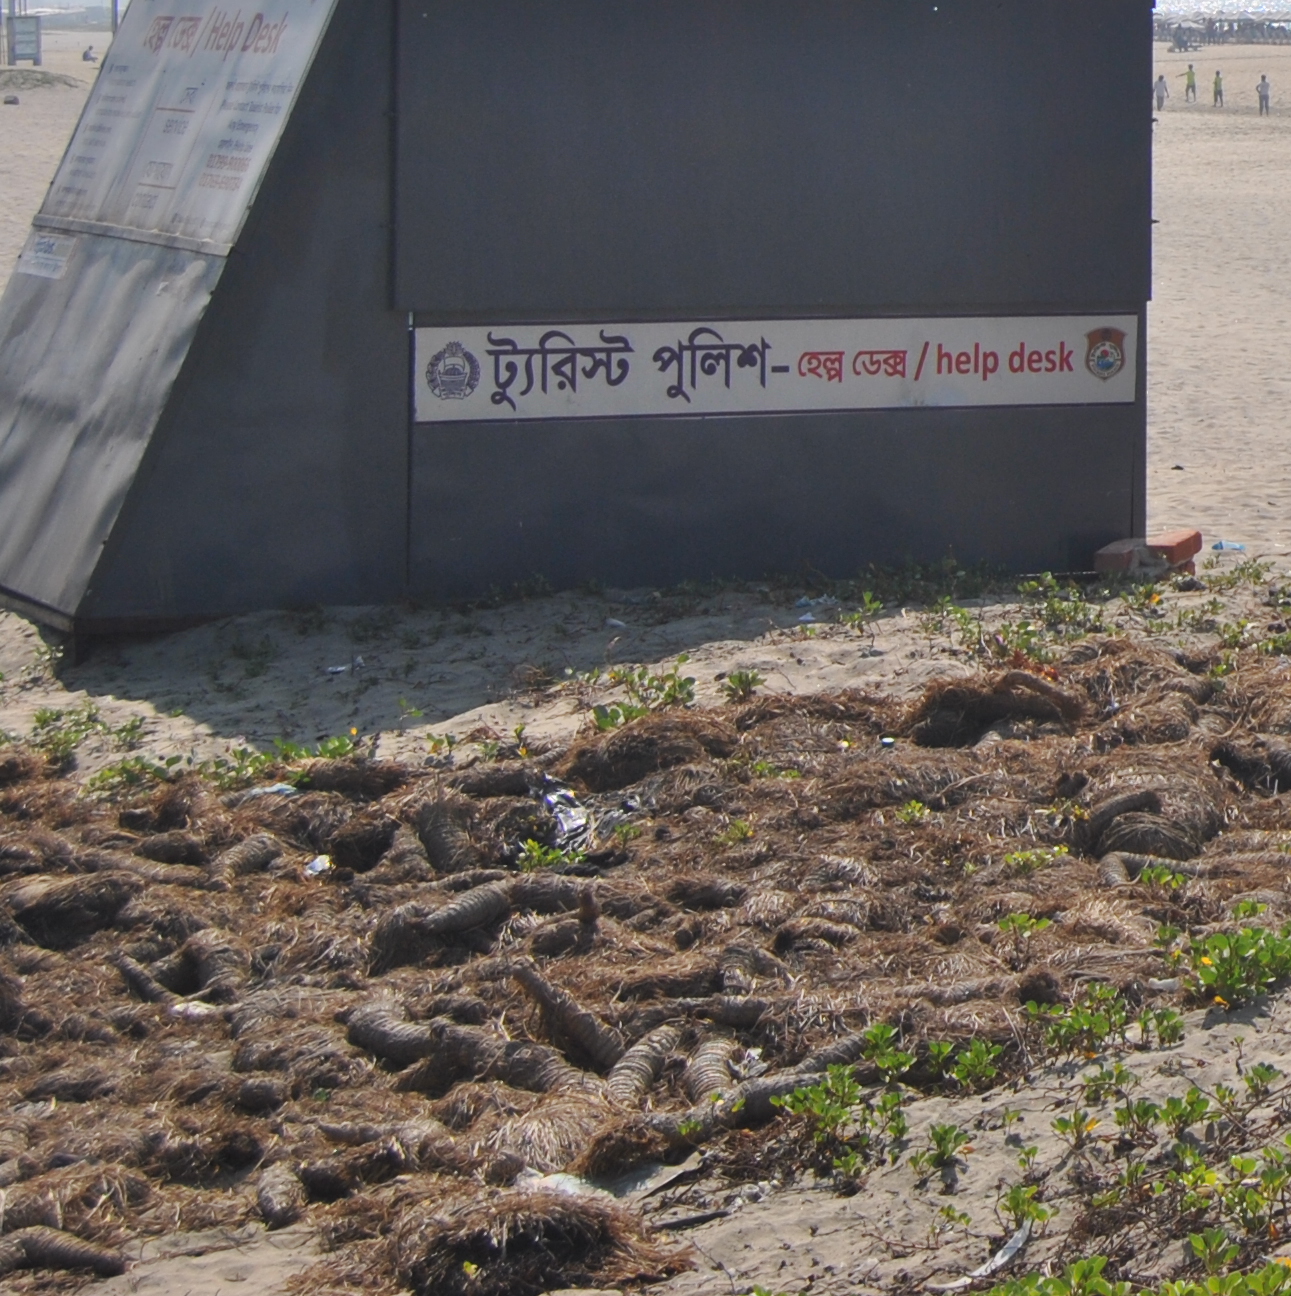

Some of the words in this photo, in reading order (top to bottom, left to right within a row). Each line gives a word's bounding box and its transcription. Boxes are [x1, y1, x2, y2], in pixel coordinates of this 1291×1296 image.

[204, 9, 244, 62] Help
[241, 10, 288, 54] Desk
[485, 329, 636, 412] ট্যুরিস্ট
[798, 351, 845, 383] হেল্প
[936, 342, 1000, 381] help
[1008, 341, 1074, 373] desk
